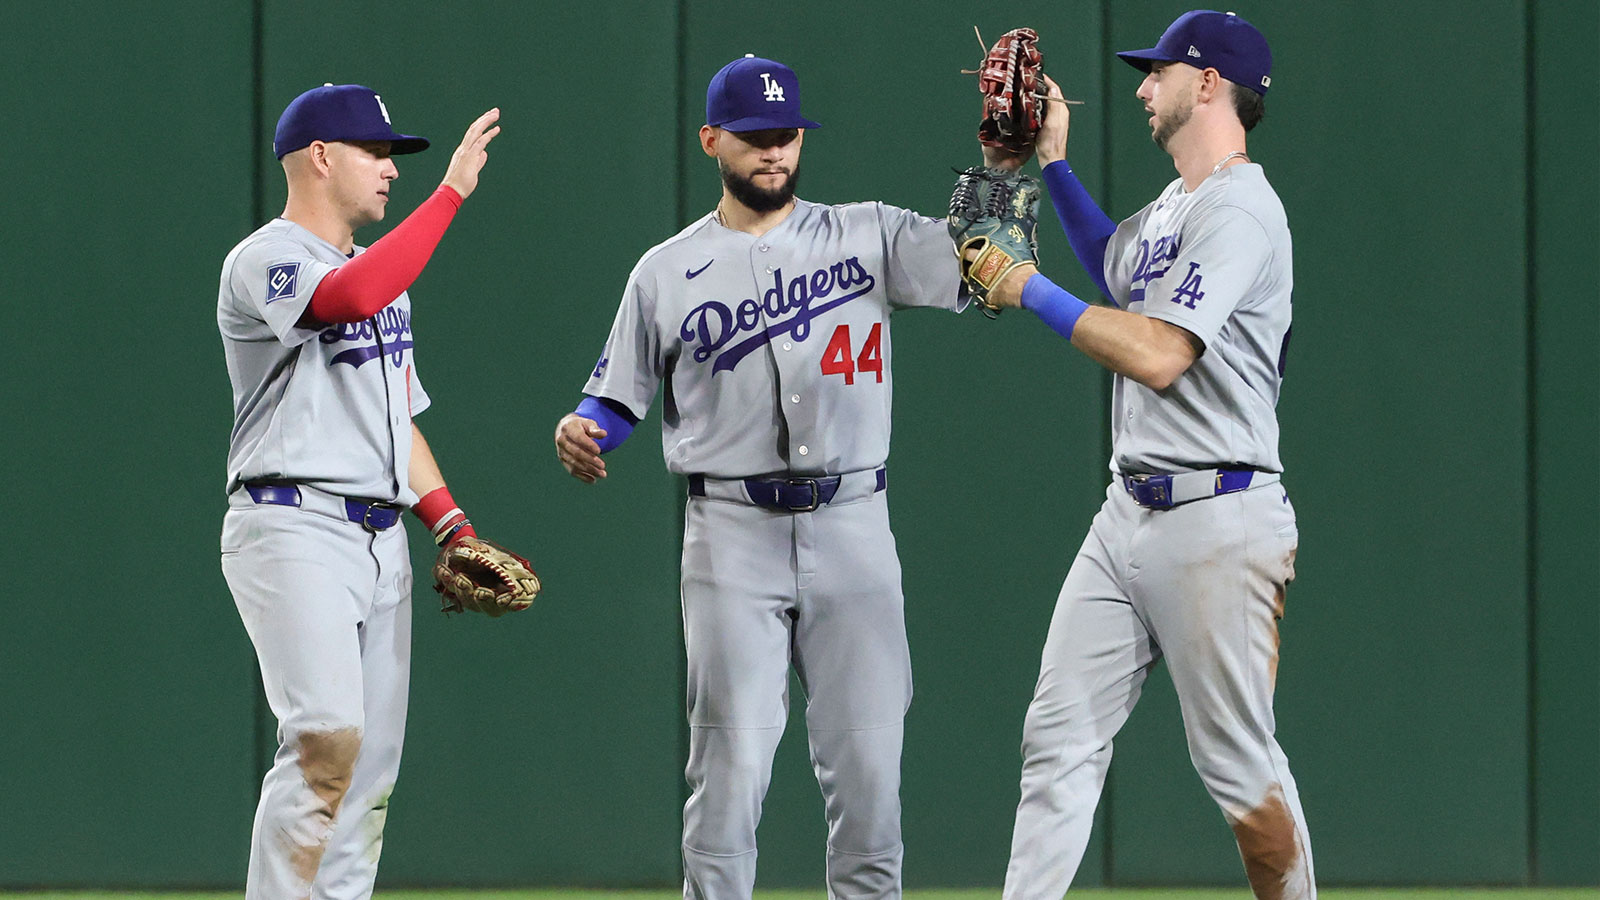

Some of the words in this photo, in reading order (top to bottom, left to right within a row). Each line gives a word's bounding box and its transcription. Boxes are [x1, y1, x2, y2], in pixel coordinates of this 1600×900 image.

[760, 73, 786, 102] LA
[680, 256, 875, 371] Dodgers
[1171, 261, 1205, 310] LA
[820, 322, 883, 386] 44
